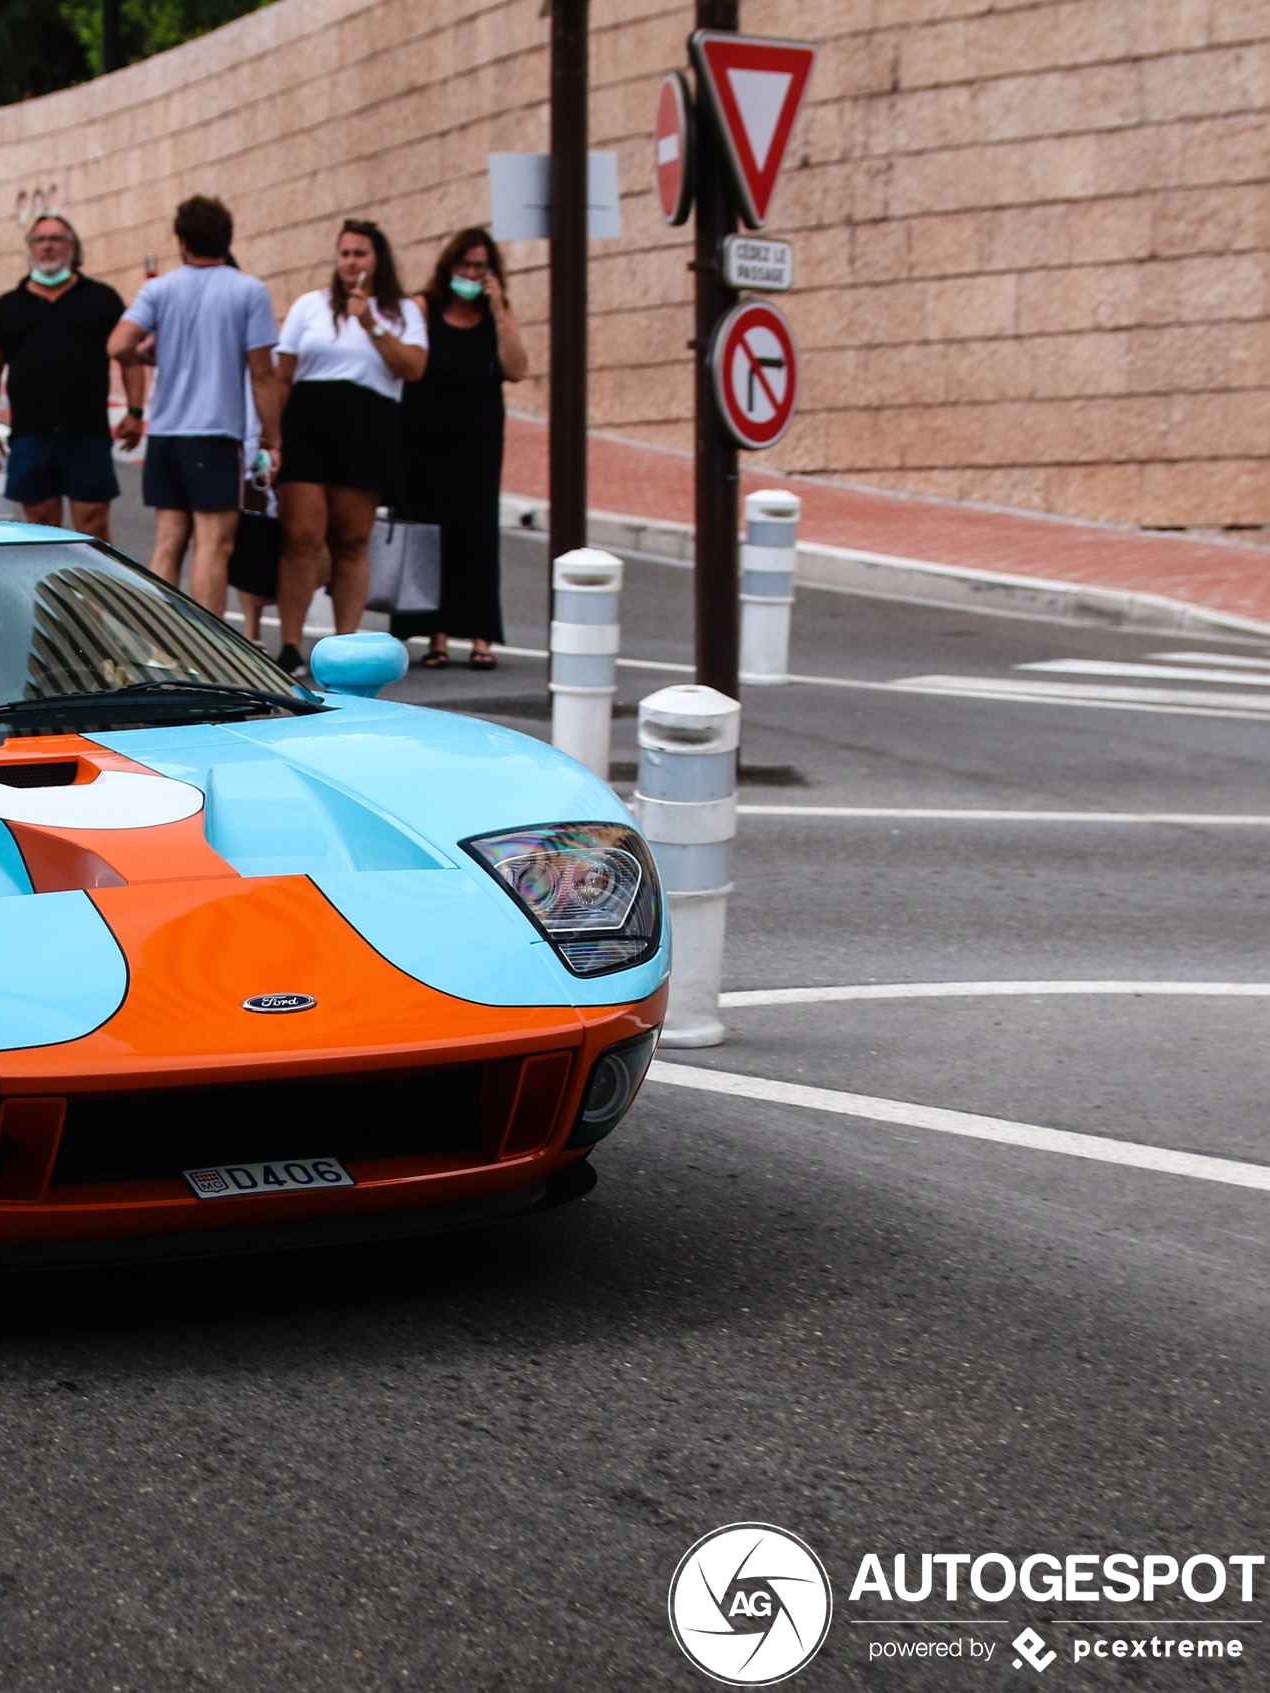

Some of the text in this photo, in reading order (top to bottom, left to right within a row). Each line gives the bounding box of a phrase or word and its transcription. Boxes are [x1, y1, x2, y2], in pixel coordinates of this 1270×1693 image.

[774, 247, 787, 264] LE
[737, 264, 786, 283] PASSAGE
[261, 995, 299, 1007] Ford
[224, 1161, 343, 1190] D406
[201, 1180, 224, 1190] MC
